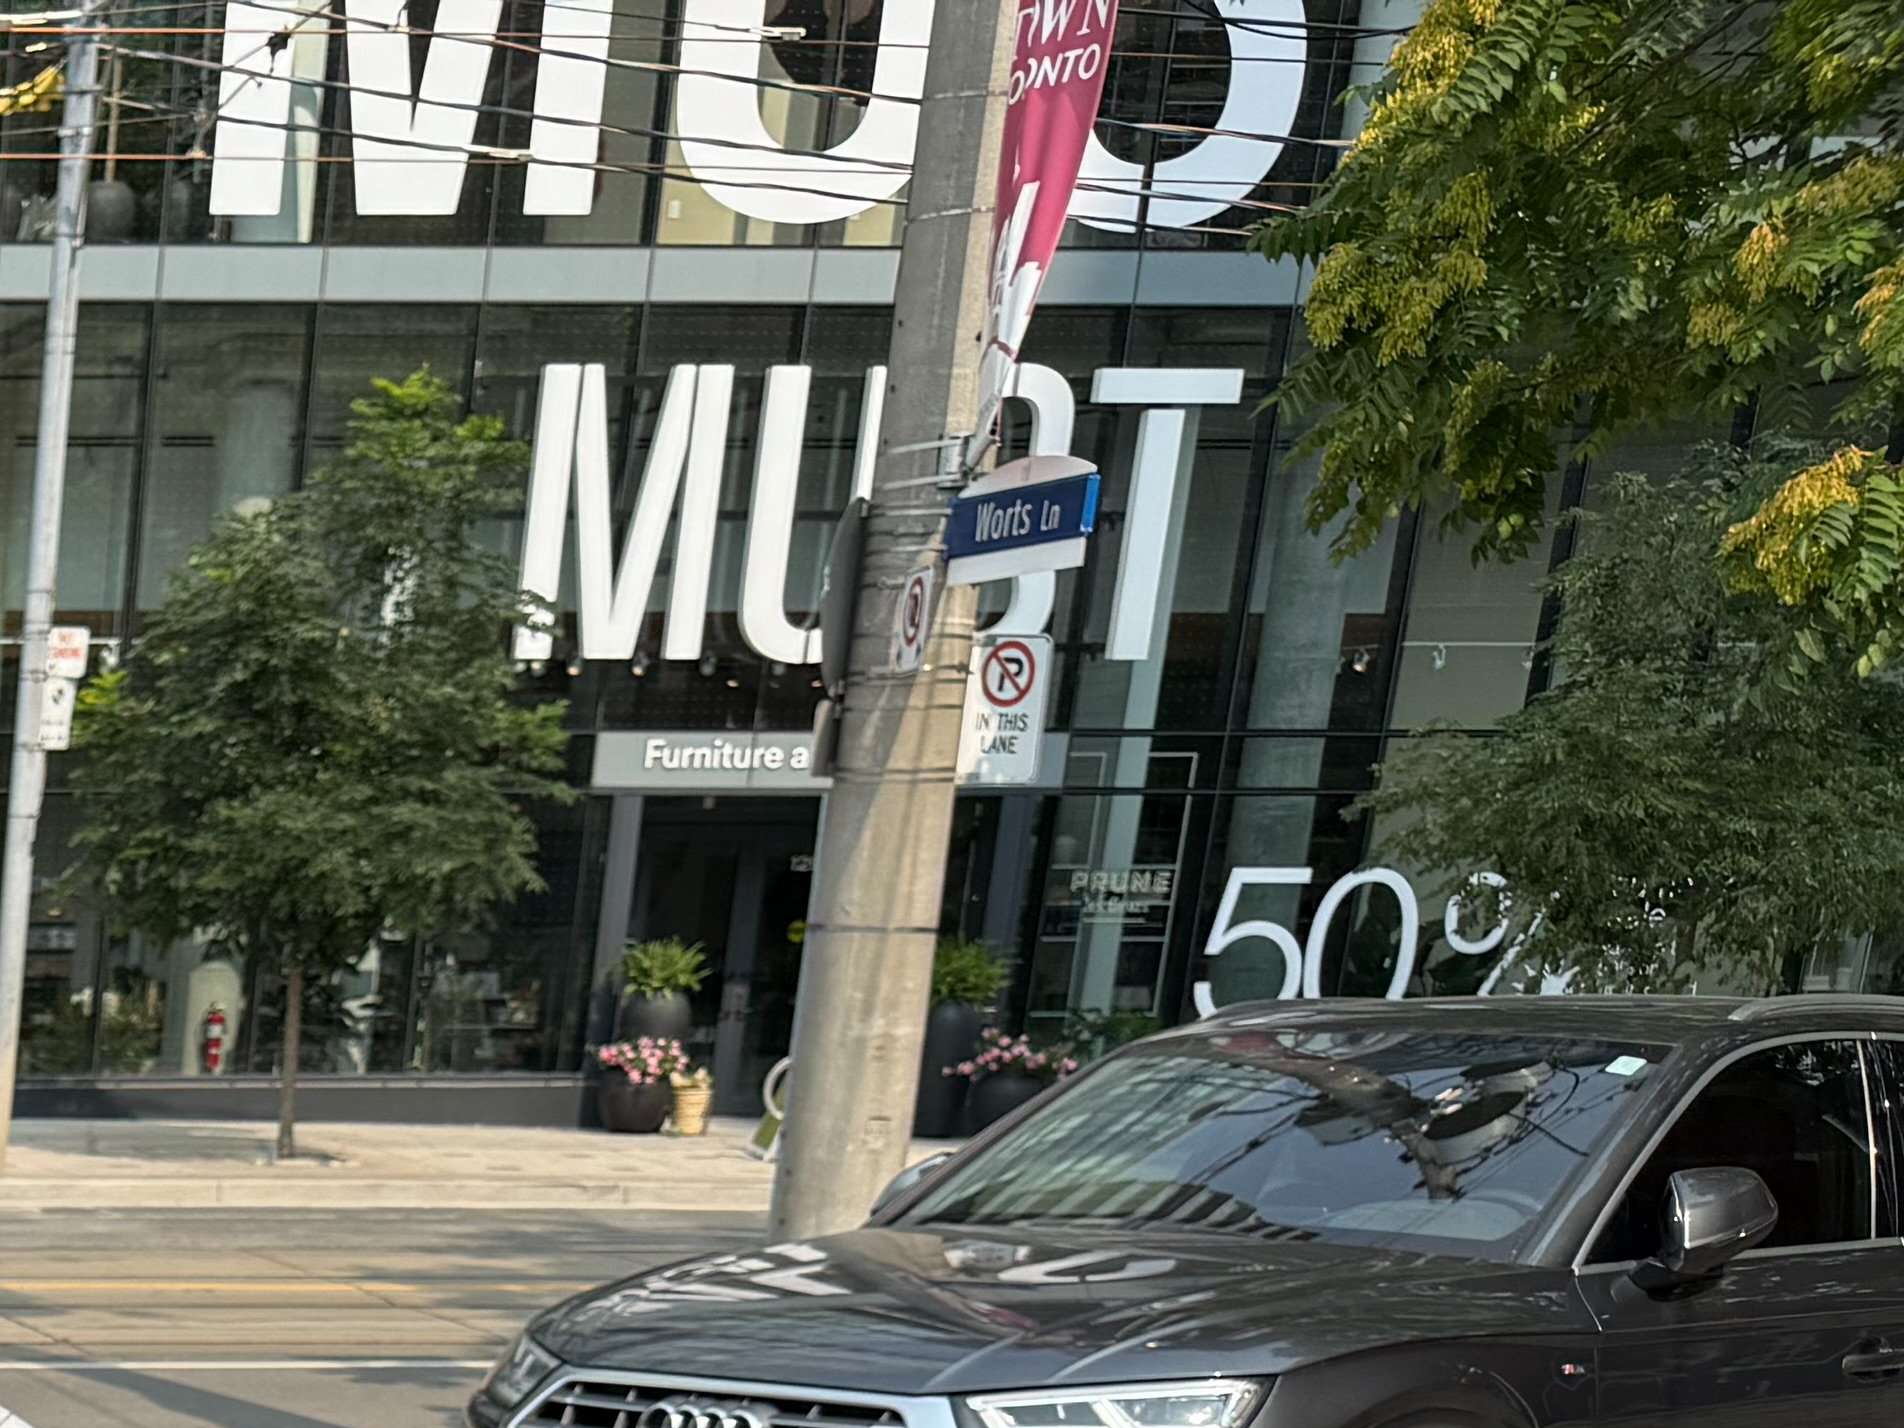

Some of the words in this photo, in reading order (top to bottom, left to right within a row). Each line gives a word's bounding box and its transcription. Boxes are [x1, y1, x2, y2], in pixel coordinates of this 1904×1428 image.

[975, 500, 1033, 542] Worts
[1040, 501, 1061, 531] Ln
[975, 711, 989, 731] IN
[996, 711, 1028, 732] THIS
[644, 738, 785, 770] Furniture
[790, 746, 810, 770] a
[980, 734, 1018, 754] LANE
[1071, 871, 1172, 894] PRUNE
